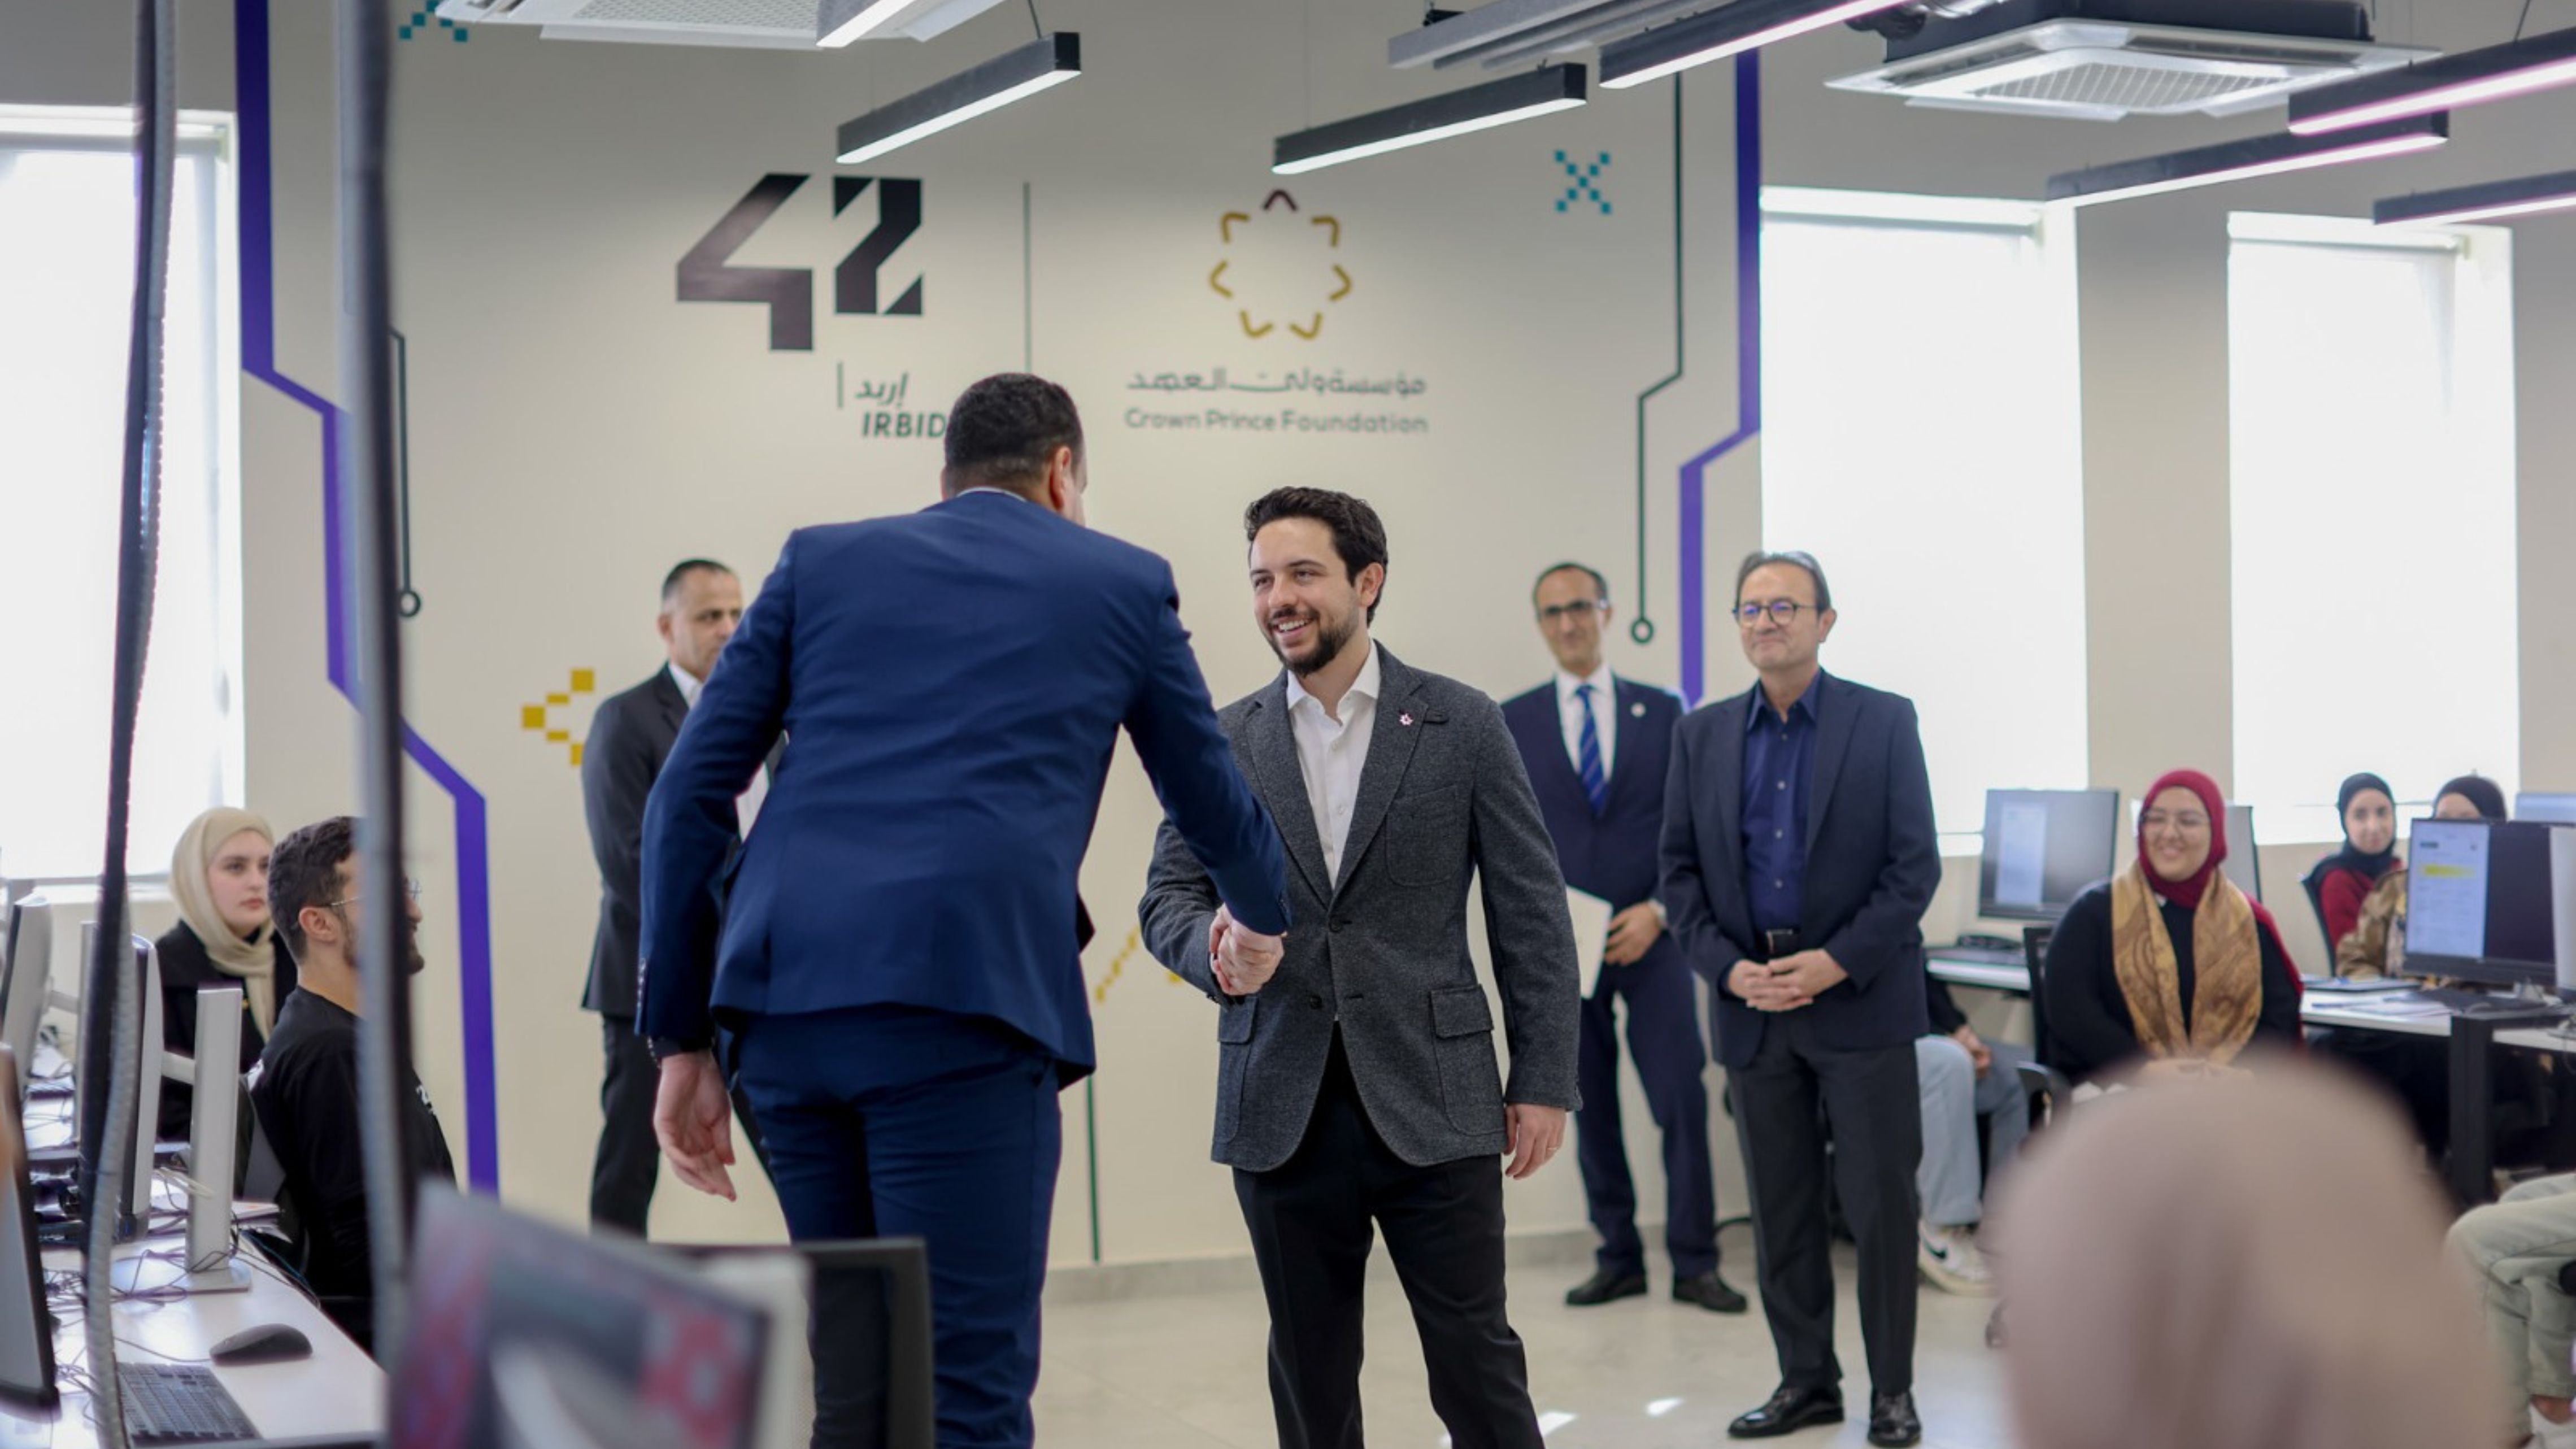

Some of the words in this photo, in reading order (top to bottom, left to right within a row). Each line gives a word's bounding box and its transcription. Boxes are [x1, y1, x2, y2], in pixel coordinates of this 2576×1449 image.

[677, 173, 924, 351] 42
[855, 372, 908, 408] إربد
[1126, 367, 1226, 391] العهد
[1328, 369, 1426, 398] مؤسسة
[863, 412, 946, 437] IRBID
[1124, 408, 1199, 429] Crown
[1206, 411, 1276, 431] Prince
[1281, 411, 1426, 433] Foundation
